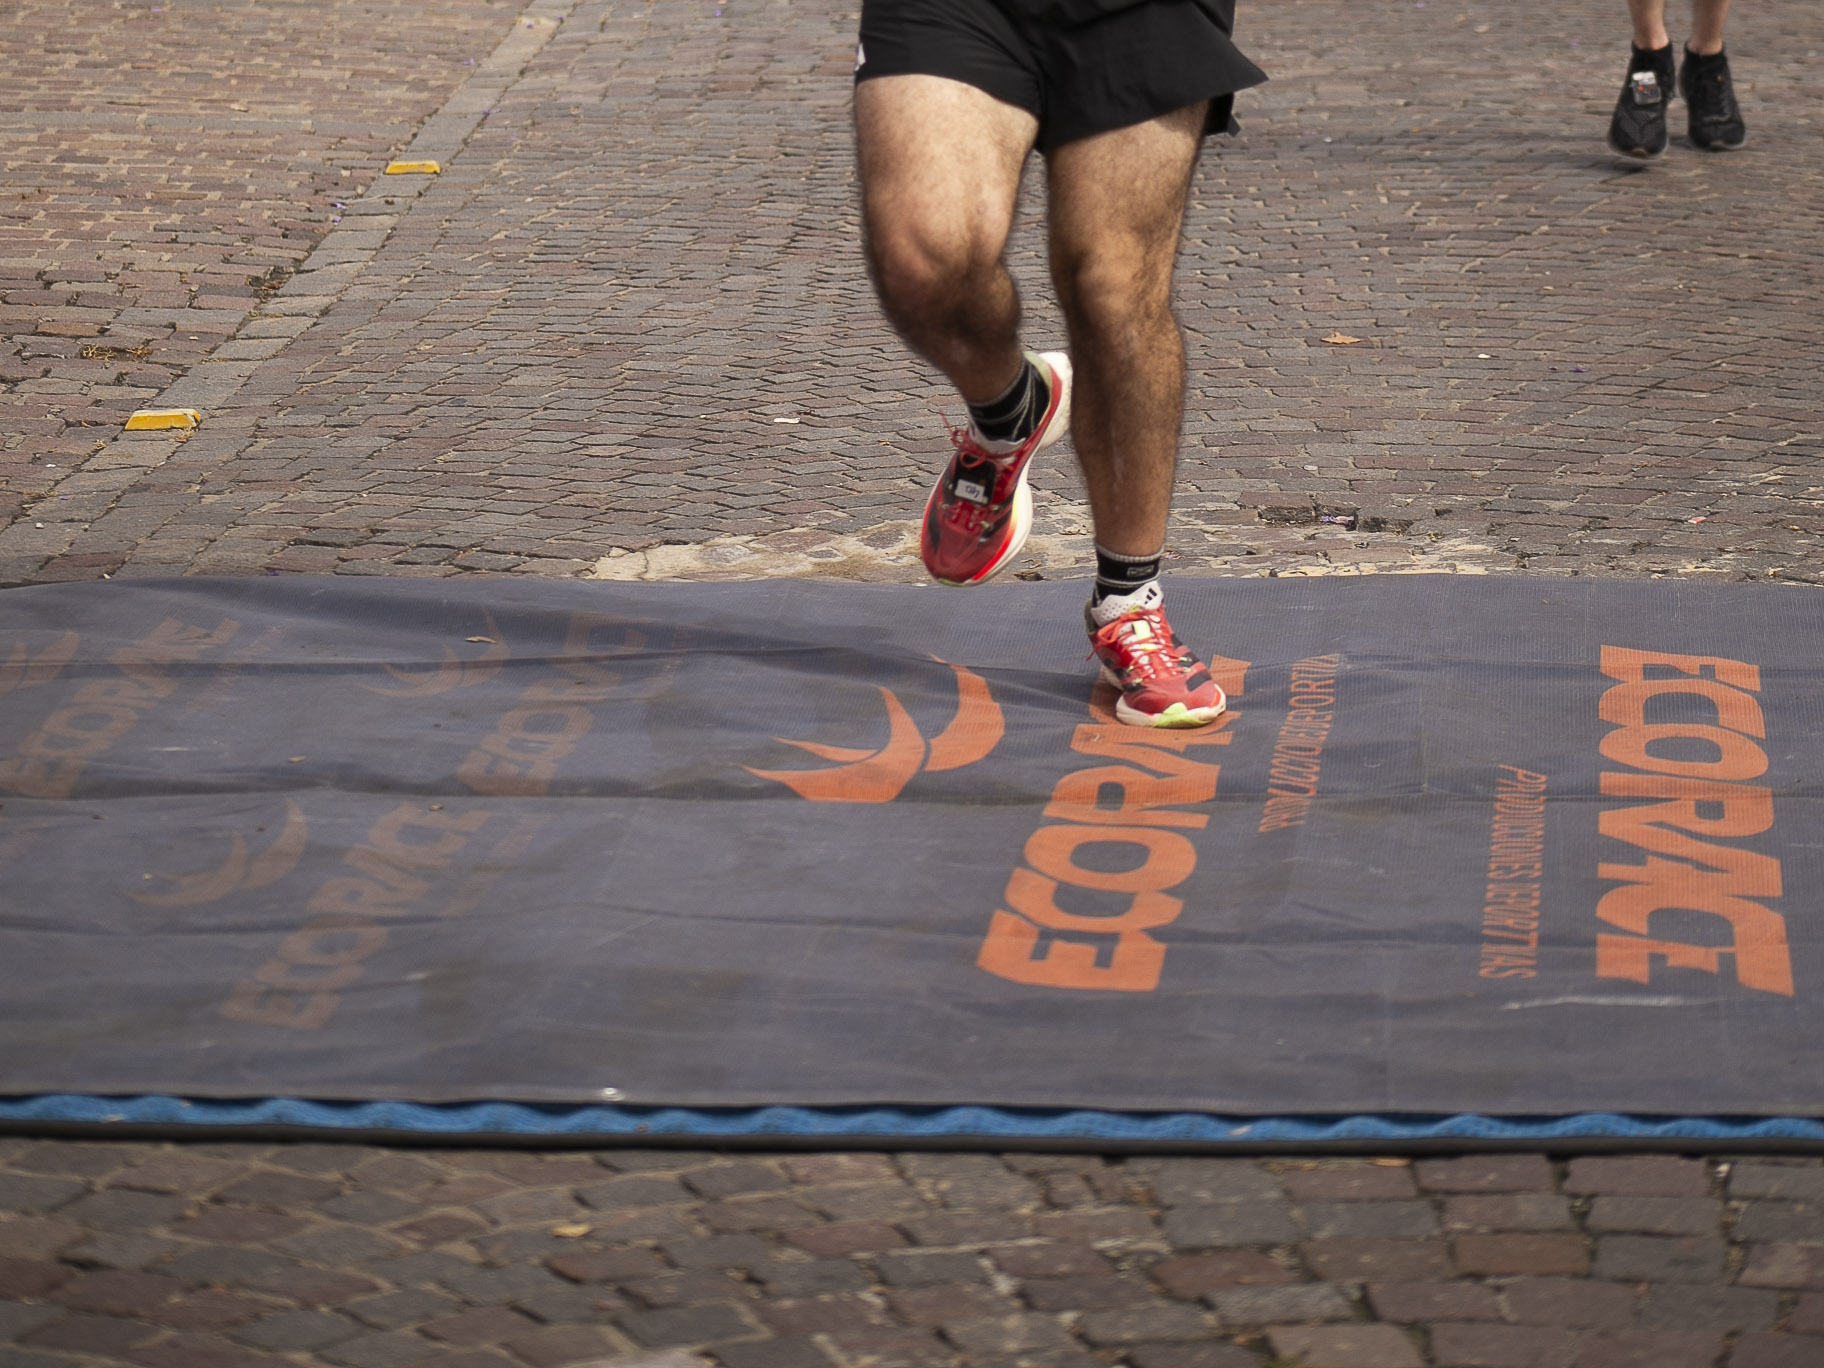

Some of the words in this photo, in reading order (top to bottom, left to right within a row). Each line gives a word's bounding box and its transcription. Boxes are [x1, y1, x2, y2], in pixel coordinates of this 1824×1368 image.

[1488, 764, 1547, 880] PRODUCCIONES
[1596, 644, 1795, 998] ECORACE
[1479, 882, 1541, 979] DEPORTIVAS
